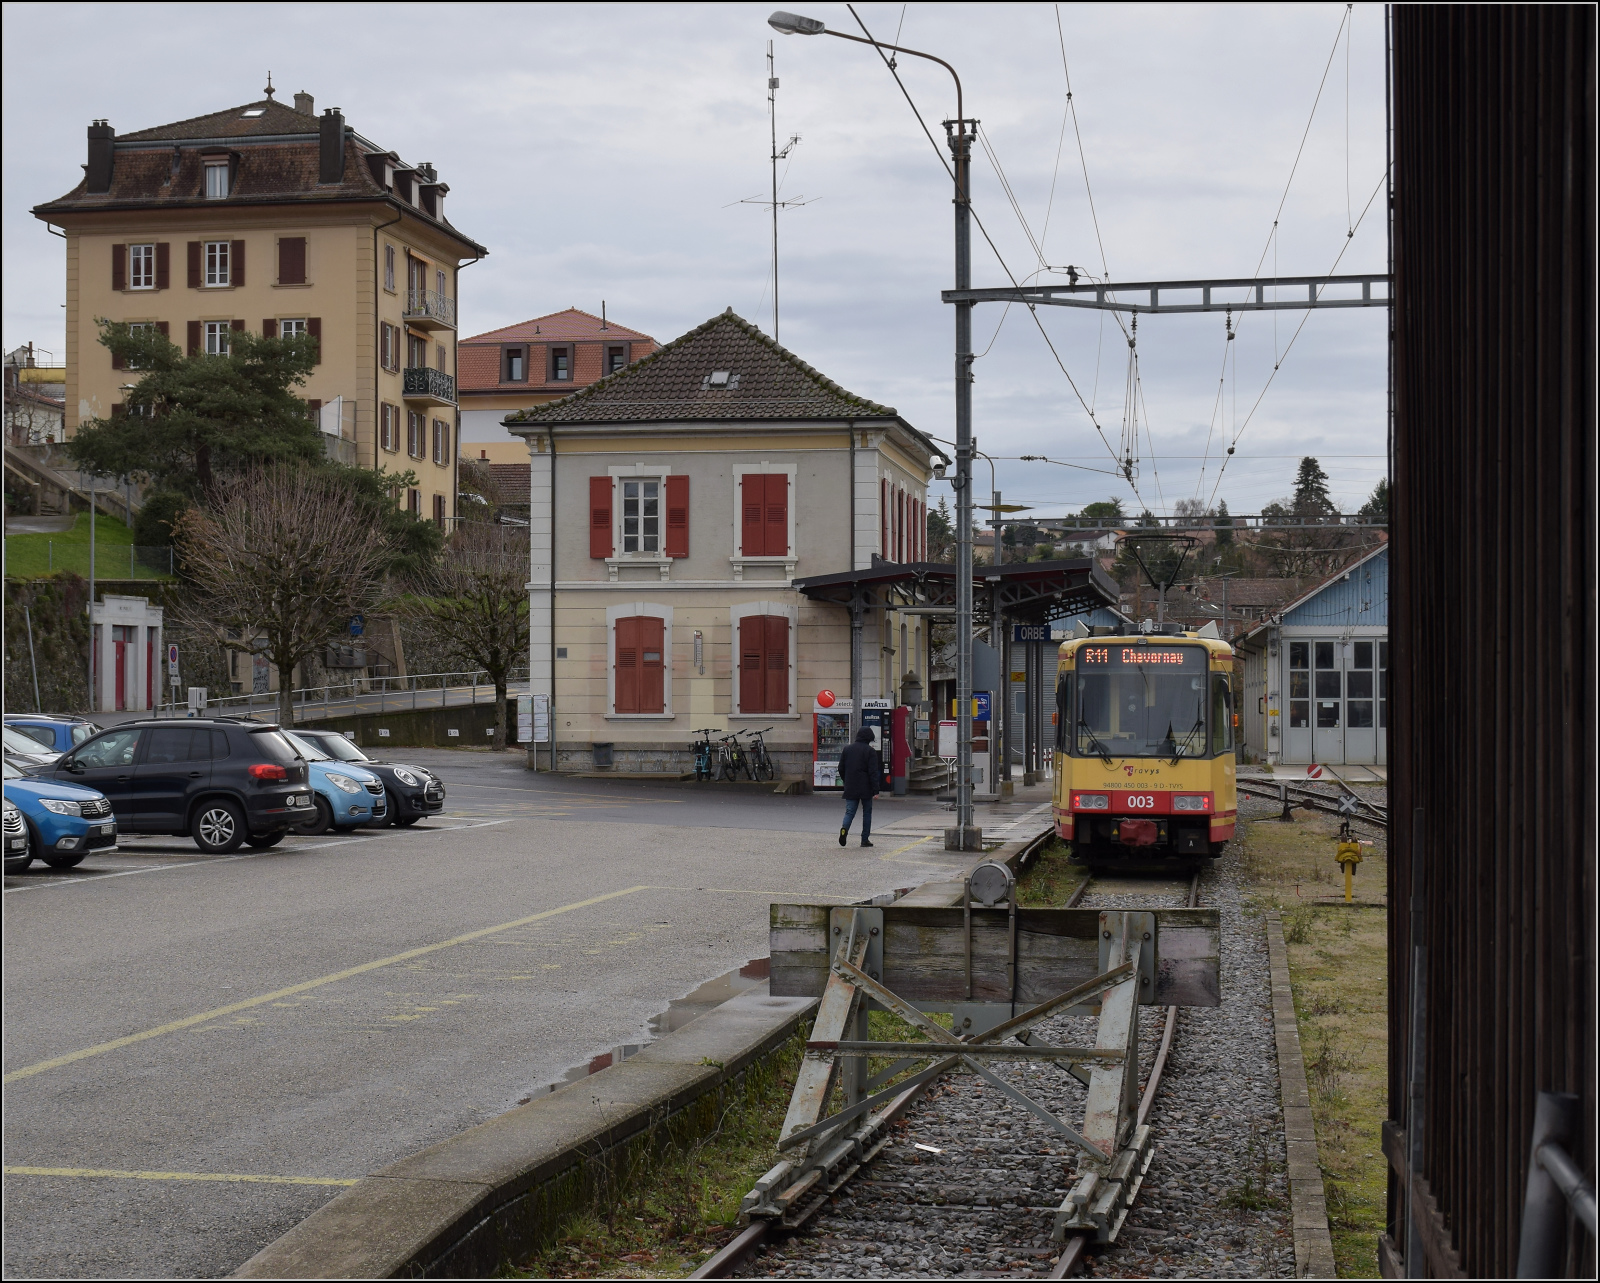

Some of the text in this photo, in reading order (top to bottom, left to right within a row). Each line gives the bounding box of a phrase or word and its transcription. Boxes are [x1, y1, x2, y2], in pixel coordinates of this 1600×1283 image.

[1021, 626, 1045, 640] ORBE
[1086, 648, 1184, 665] R11 Chavornay
[1126, 766, 1160, 776] travys
[1127, 795, 1155, 808] 003
